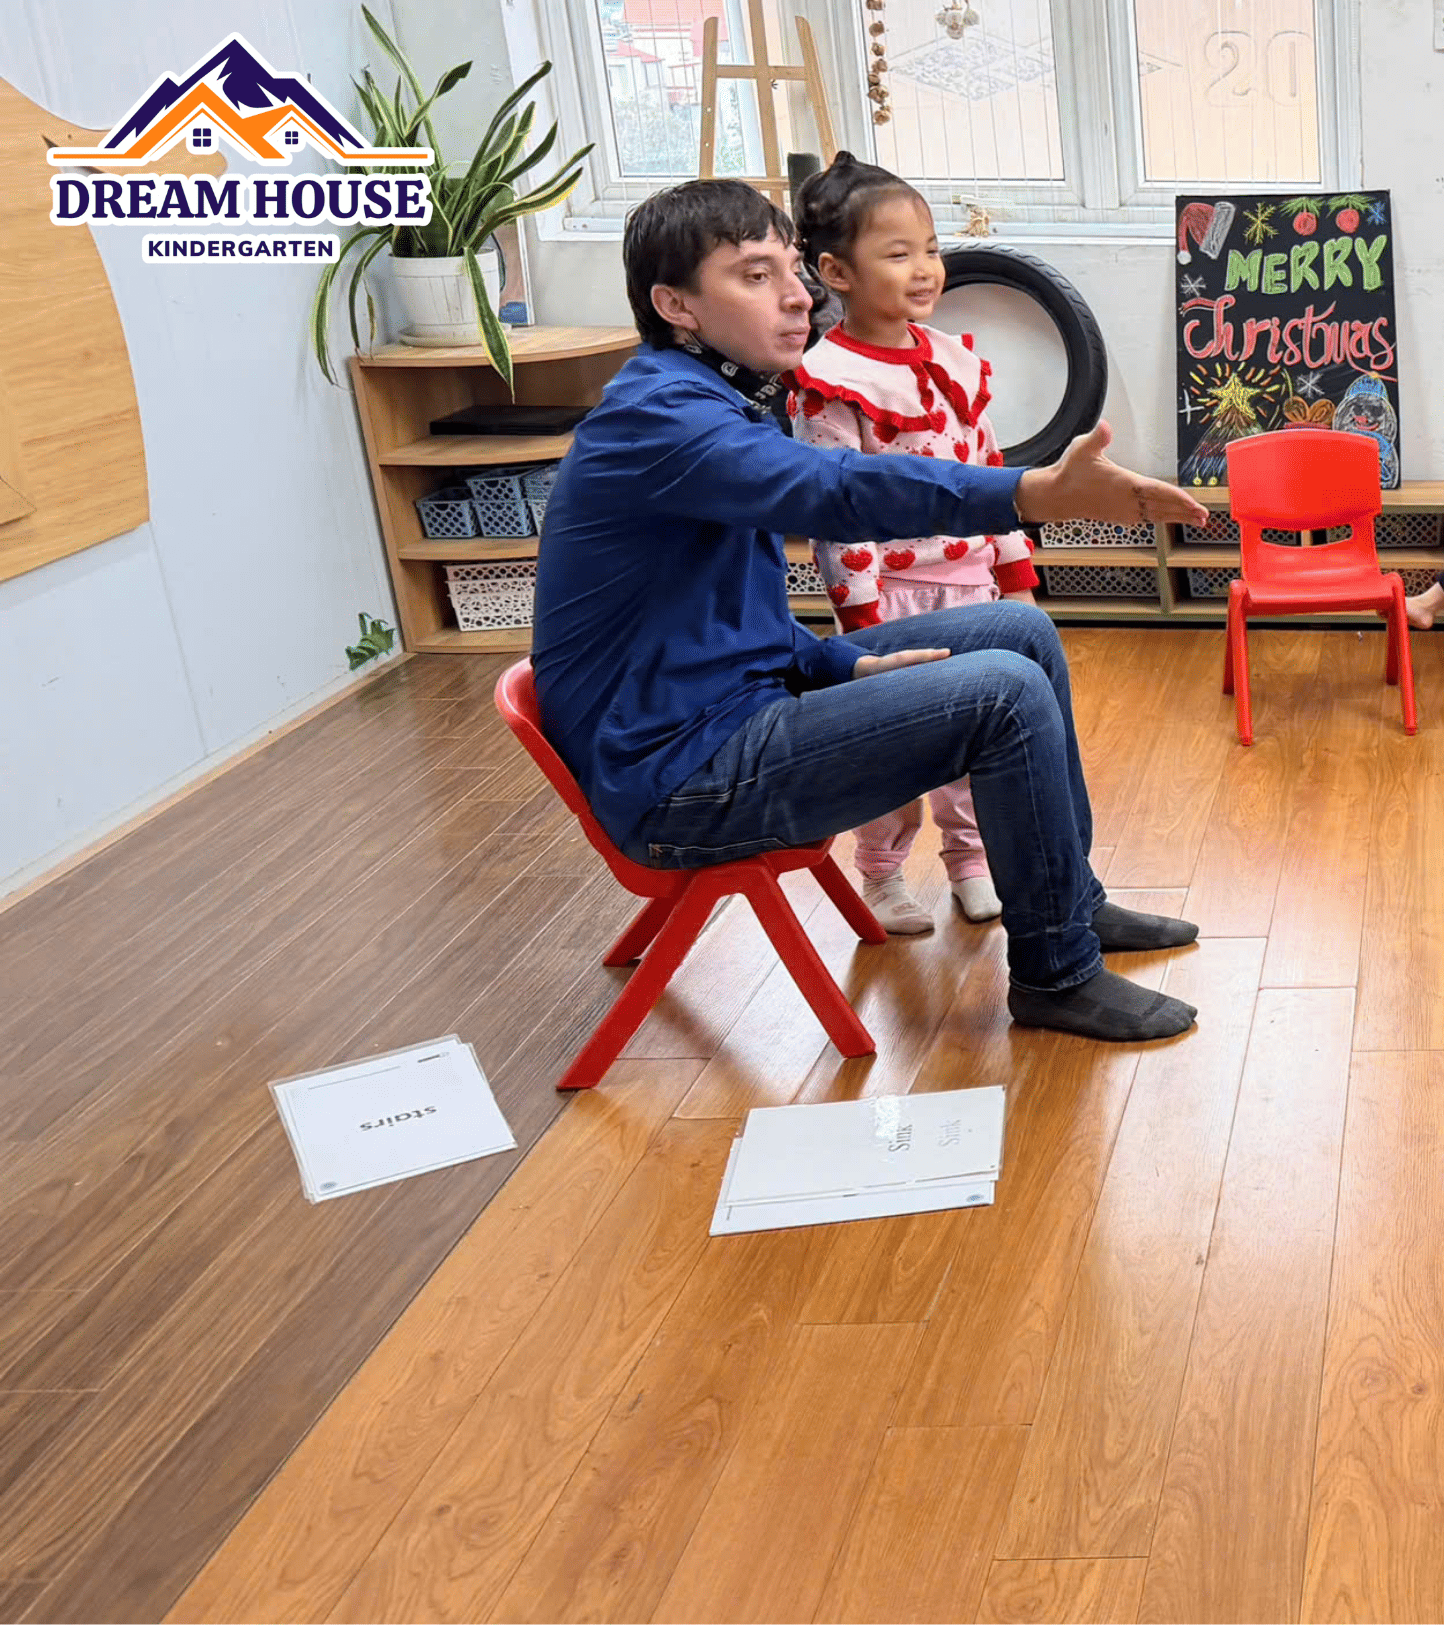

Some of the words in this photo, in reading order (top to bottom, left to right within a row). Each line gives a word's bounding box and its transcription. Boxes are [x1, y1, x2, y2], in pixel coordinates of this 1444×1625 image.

[1224, 234, 1388, 295] MERRY
[1179, 294, 1396, 370] Christmas
[359, 1105, 438, 1132] stairs
[887, 1123, 913, 1153] Sink
